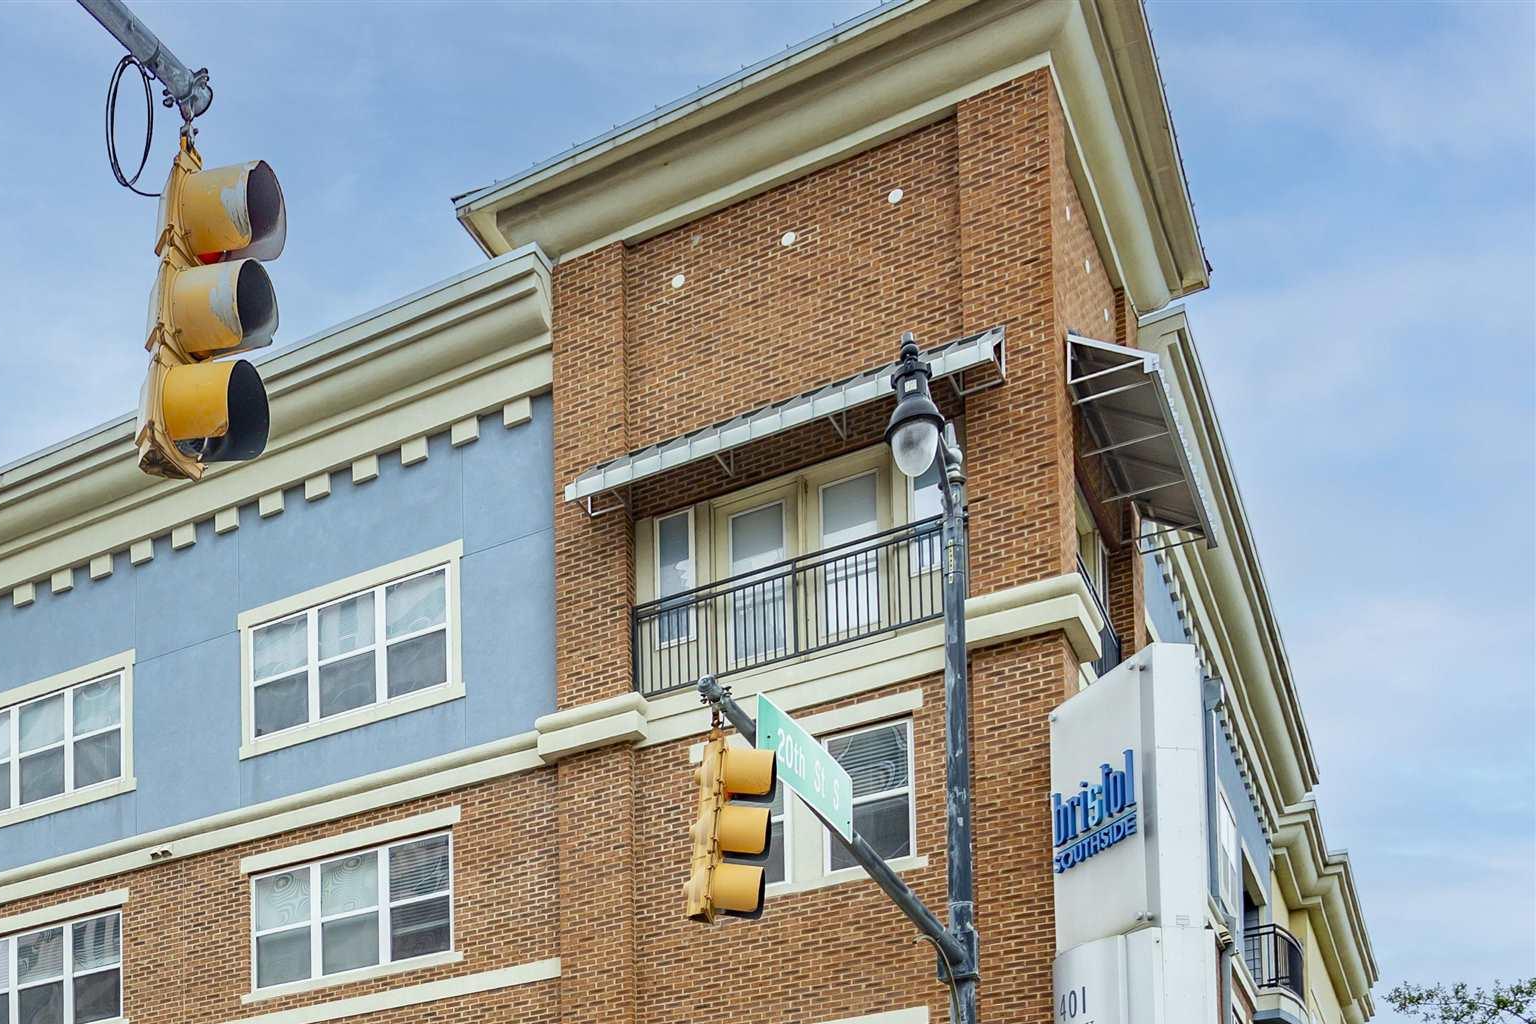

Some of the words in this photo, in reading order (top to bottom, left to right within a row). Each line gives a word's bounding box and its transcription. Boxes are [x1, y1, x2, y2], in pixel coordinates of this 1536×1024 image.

[777, 727, 806, 780] 20th
[814, 760, 825, 798] St
[832, 778, 841, 811] S
[1052, 749, 1137, 848] bristol
[1053, 813, 1138, 874] SOUTHSIDE
[1060, 986, 1086, 1021] 401
